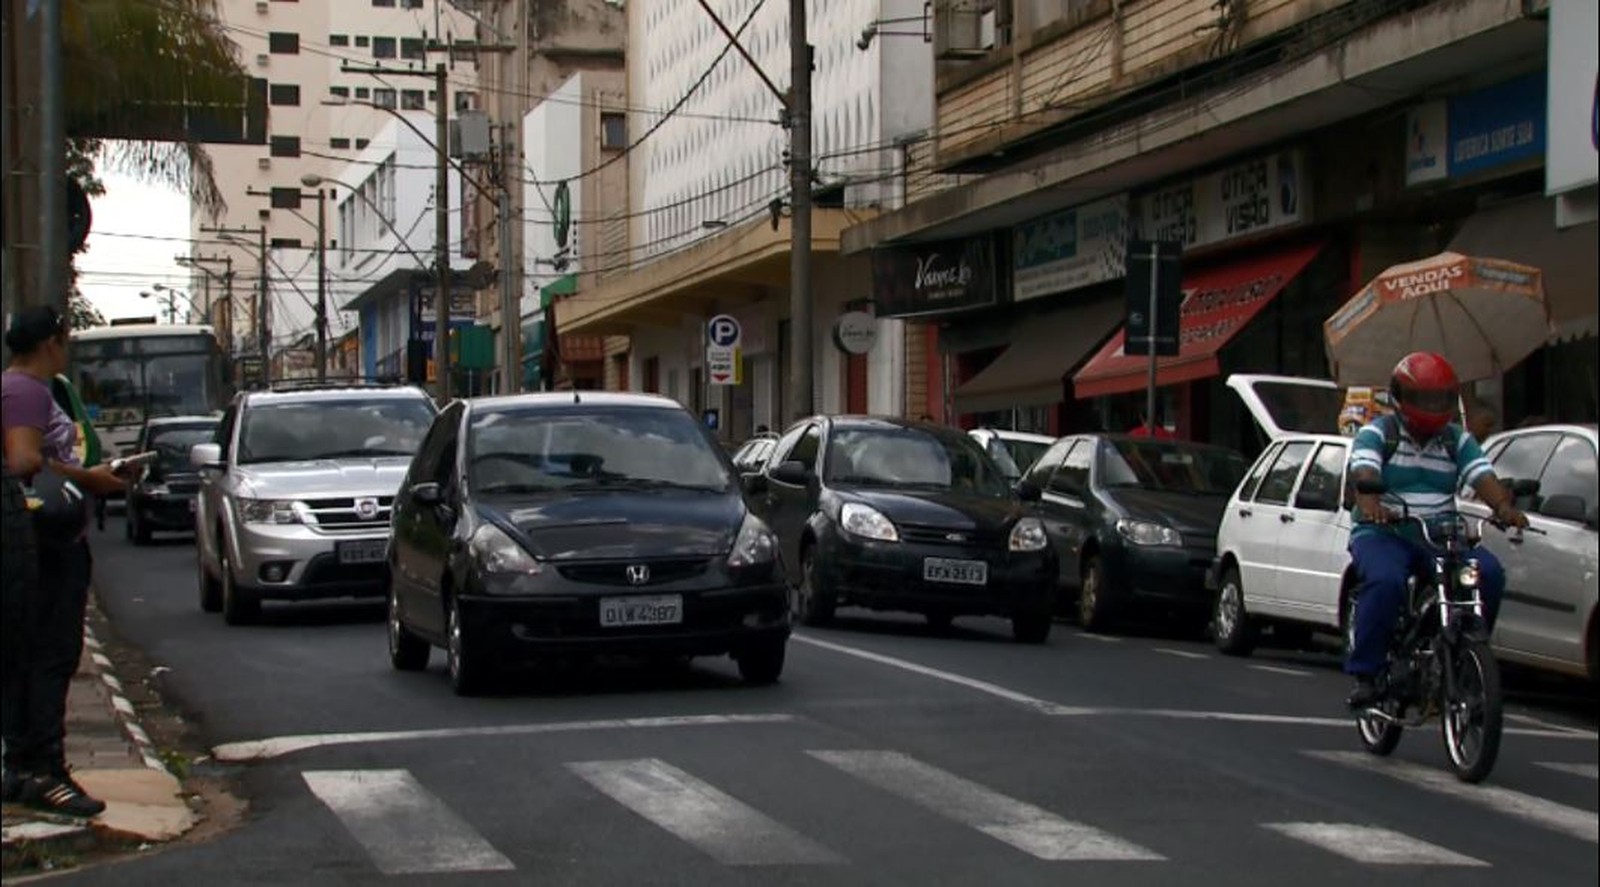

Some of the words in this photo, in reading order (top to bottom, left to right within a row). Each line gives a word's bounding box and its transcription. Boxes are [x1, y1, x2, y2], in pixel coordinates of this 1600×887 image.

[1384, 265, 1463, 291] VENDAS
[1401, 279, 1450, 300] AQUI
[714, 321, 735, 344] P
